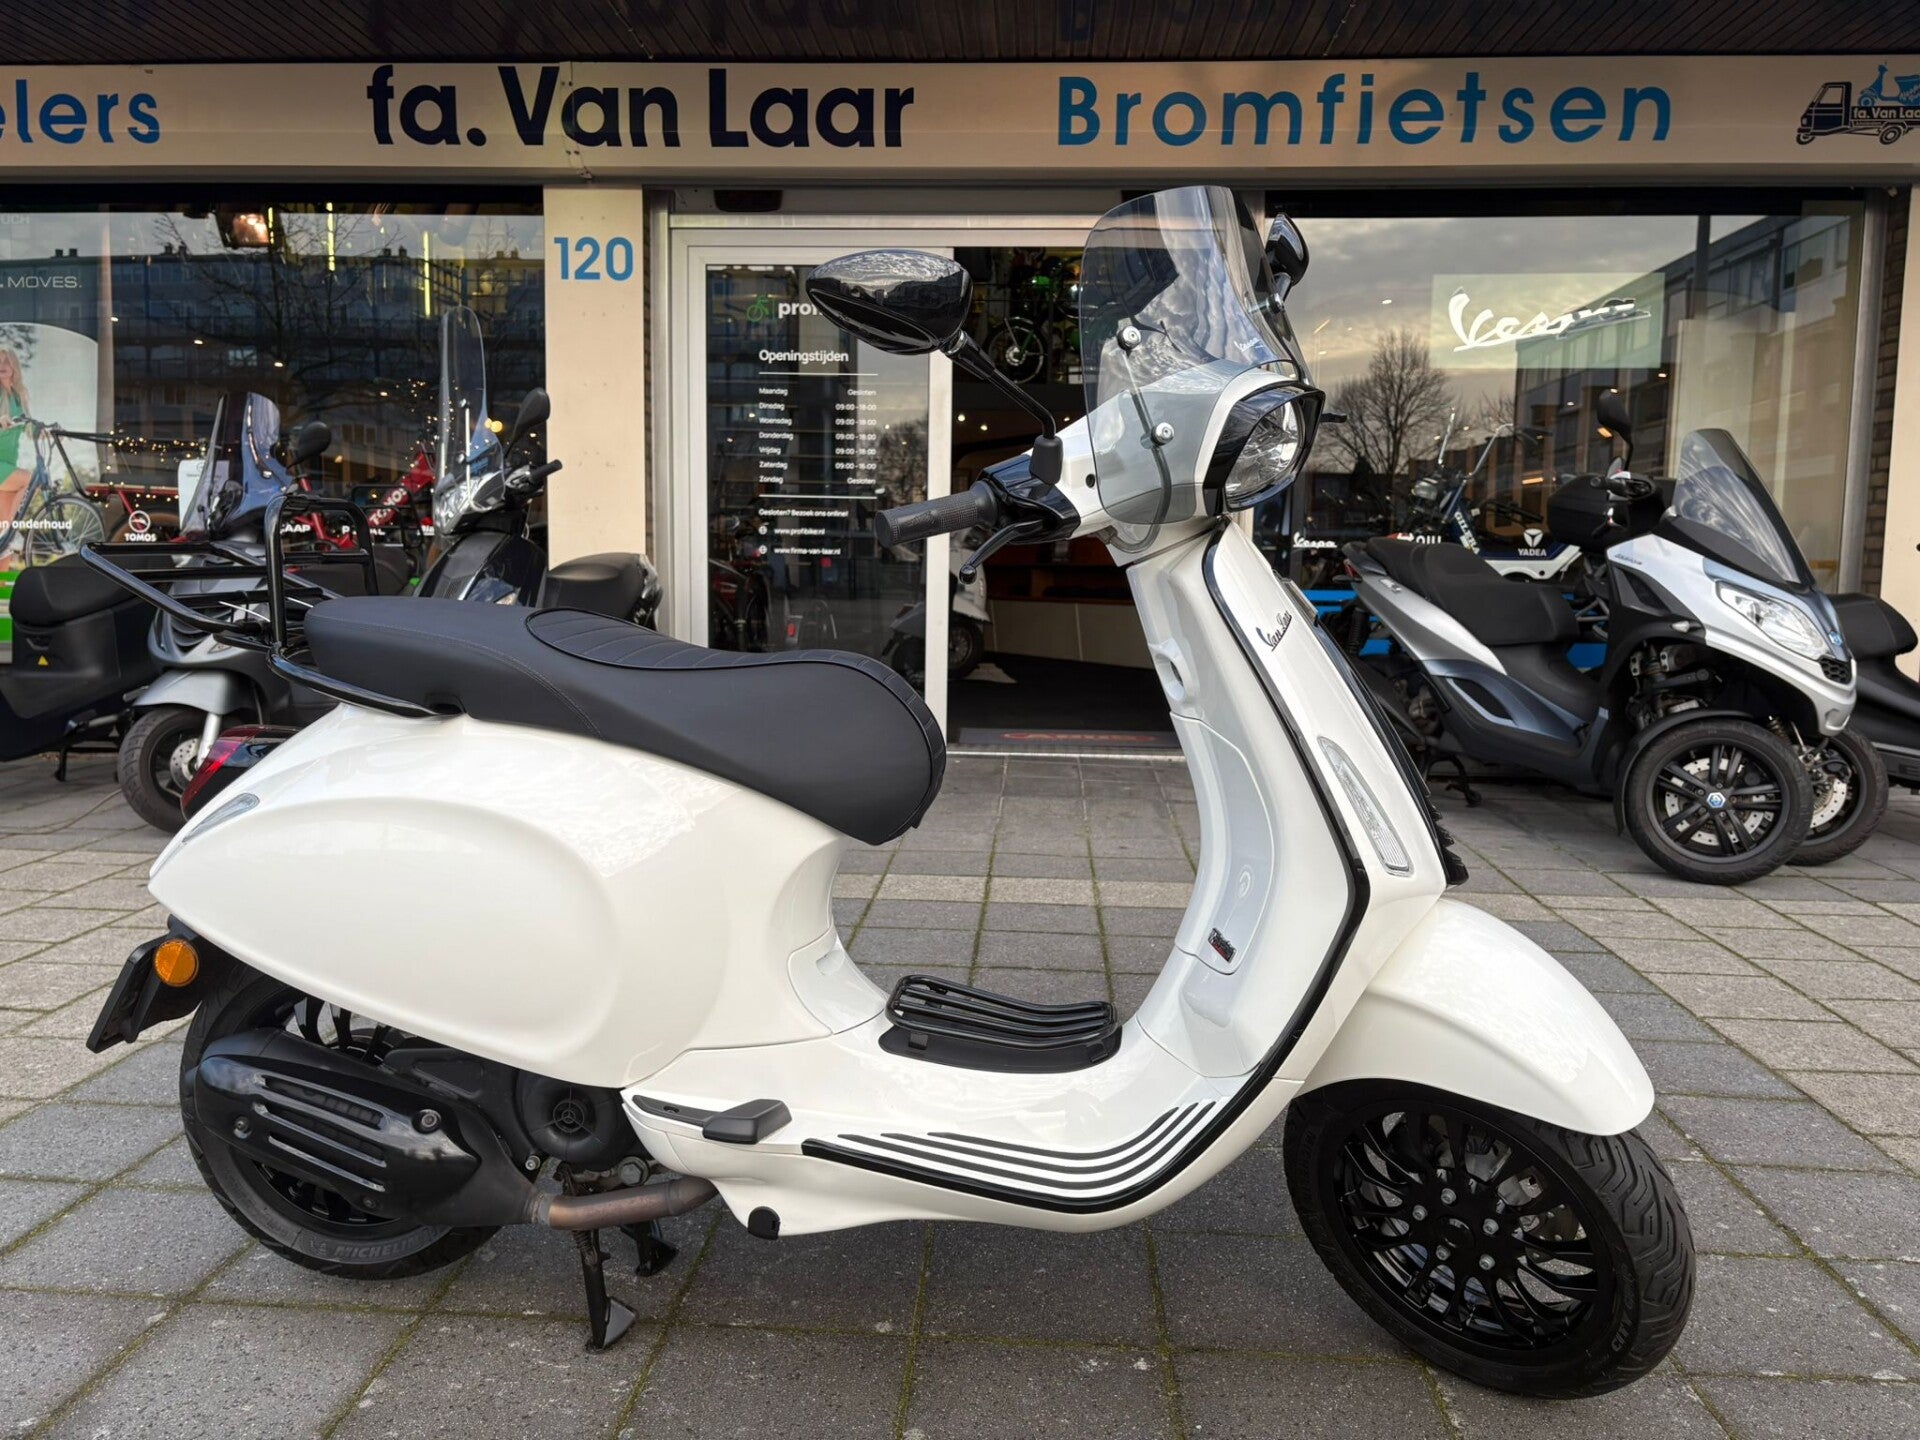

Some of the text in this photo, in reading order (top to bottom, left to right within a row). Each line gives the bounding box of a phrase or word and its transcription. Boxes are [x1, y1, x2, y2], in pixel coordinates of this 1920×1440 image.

[0, 79, 160, 144] lers
[497, 66, 681, 148] Van
[708, 69, 914, 148] Laar
[1057, 72, 1671, 147] Bromfietsen
[1871, 107, 1897, 119] Van
[554, 237, 634, 281] 120
[8, 276, 82, 288] MOVES.
[758, 350, 849, 364] Openingstijden
[759, 388, 788, 397] Maandag
[759, 402, 785, 411] Dinsdag
[759, 418, 792, 426] Woensdag
[759, 432, 794, 441] Donderdag
[759, 446, 781, 455] Vrijdag
[759, 461, 788, 470] Zaterdag
[759, 475, 783, 484] Zondag
[12, 518, 73, 531] onderhoud
[124, 532, 156, 542] TOMOS
[1293, 532, 1338, 549] Vespa
[1518, 548, 1547, 557] YADEA
